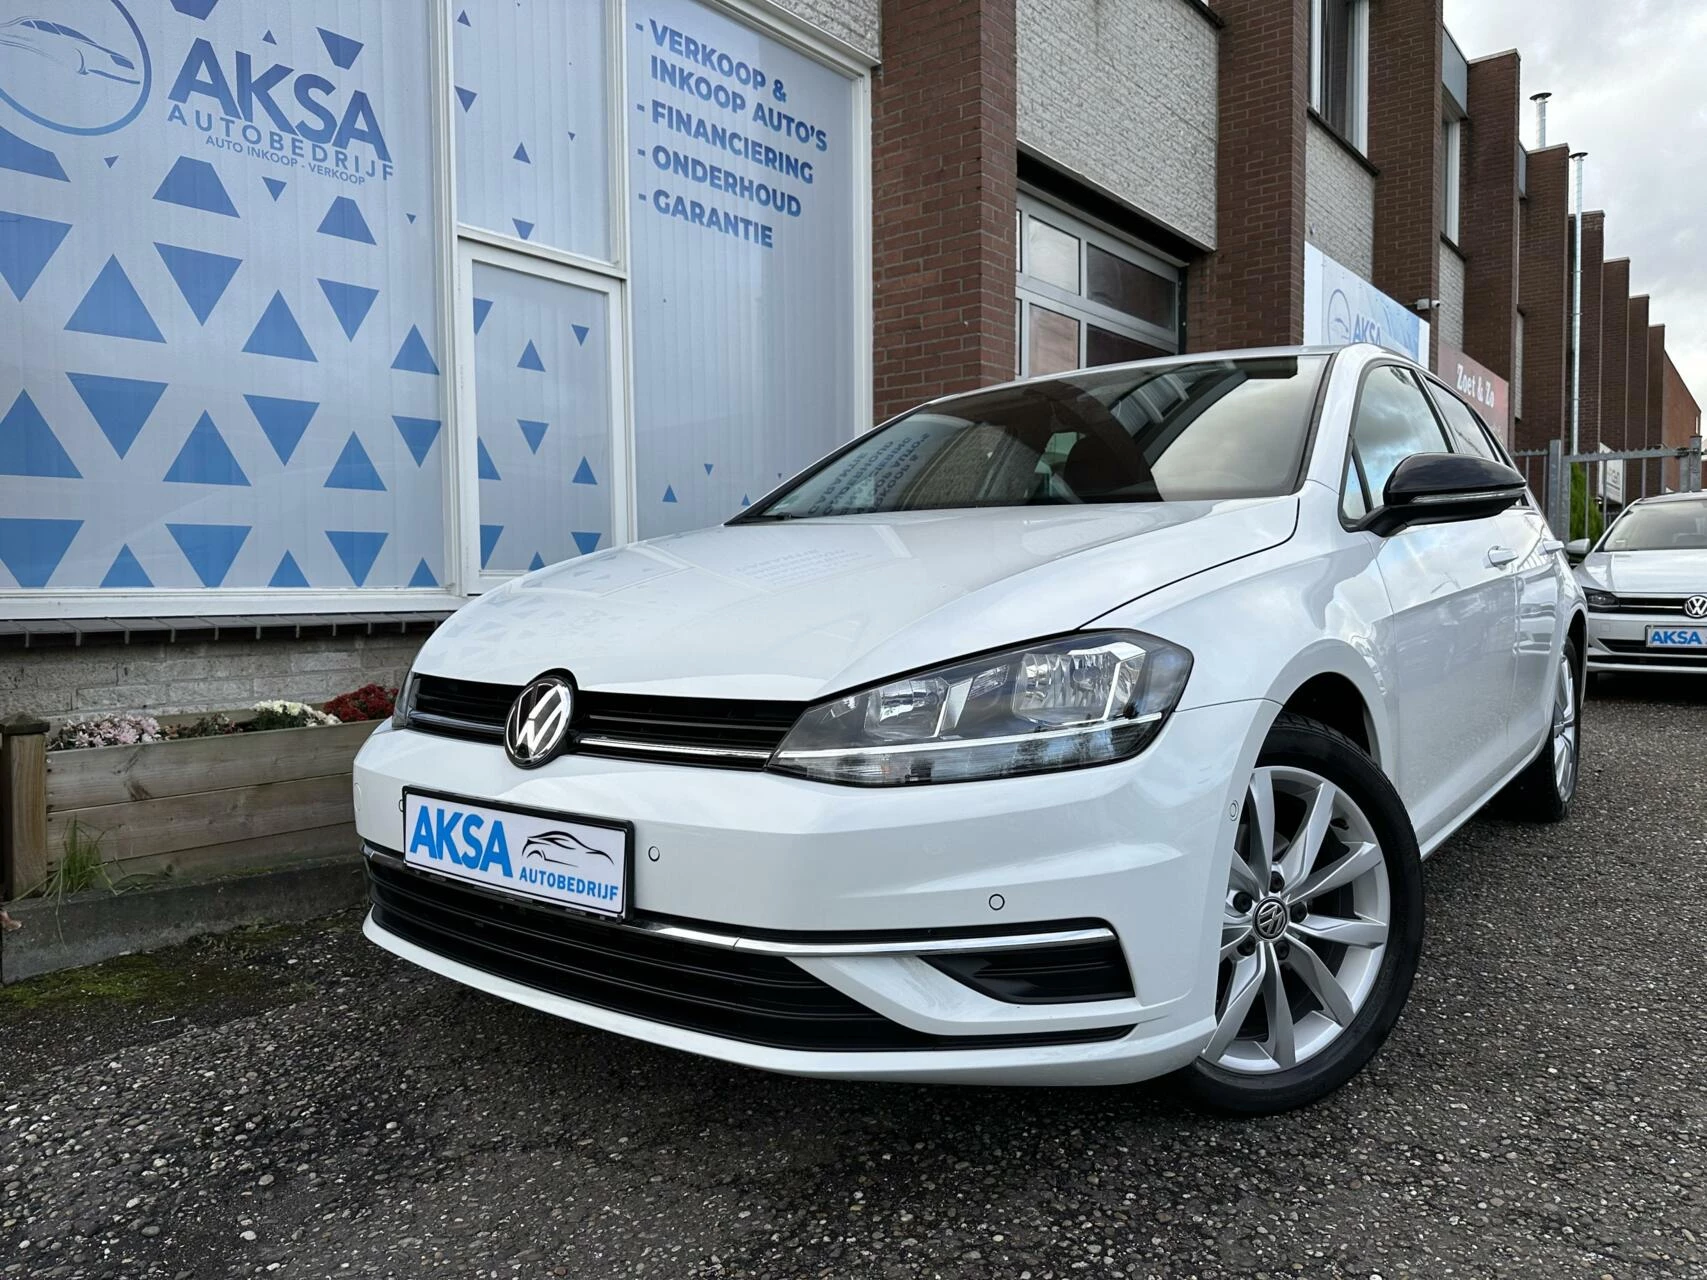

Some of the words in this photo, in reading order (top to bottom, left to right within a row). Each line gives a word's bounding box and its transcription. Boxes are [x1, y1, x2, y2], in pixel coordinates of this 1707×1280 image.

[649, 18, 766, 91] VERKOOP
[773, 79, 787, 102] &
[168, 37, 392, 163] AKSA
[651, 54, 746, 114] INKOOP
[752, 102, 828, 152] AUTO'S
[167, 103, 394, 181] AUTOBEDRIJF
[206, 136, 243, 154] AUTO
[247, 145, 298, 168] INKOOP
[308, 162, 365, 185] VERKOOP
[652, 99, 814, 184] FINANCIERING
[652, 145, 801, 217] ONDERHOUD
[653, 189, 773, 248] GARANTIE
[1353, 313, 1381, 346] AKSA
[1457, 363, 1476, 398] Zoet
[1651, 630, 1703, 645] AKSA
[410, 805, 513, 878] AKSA
[519, 866, 619, 901] AUTOBEDRIJF
